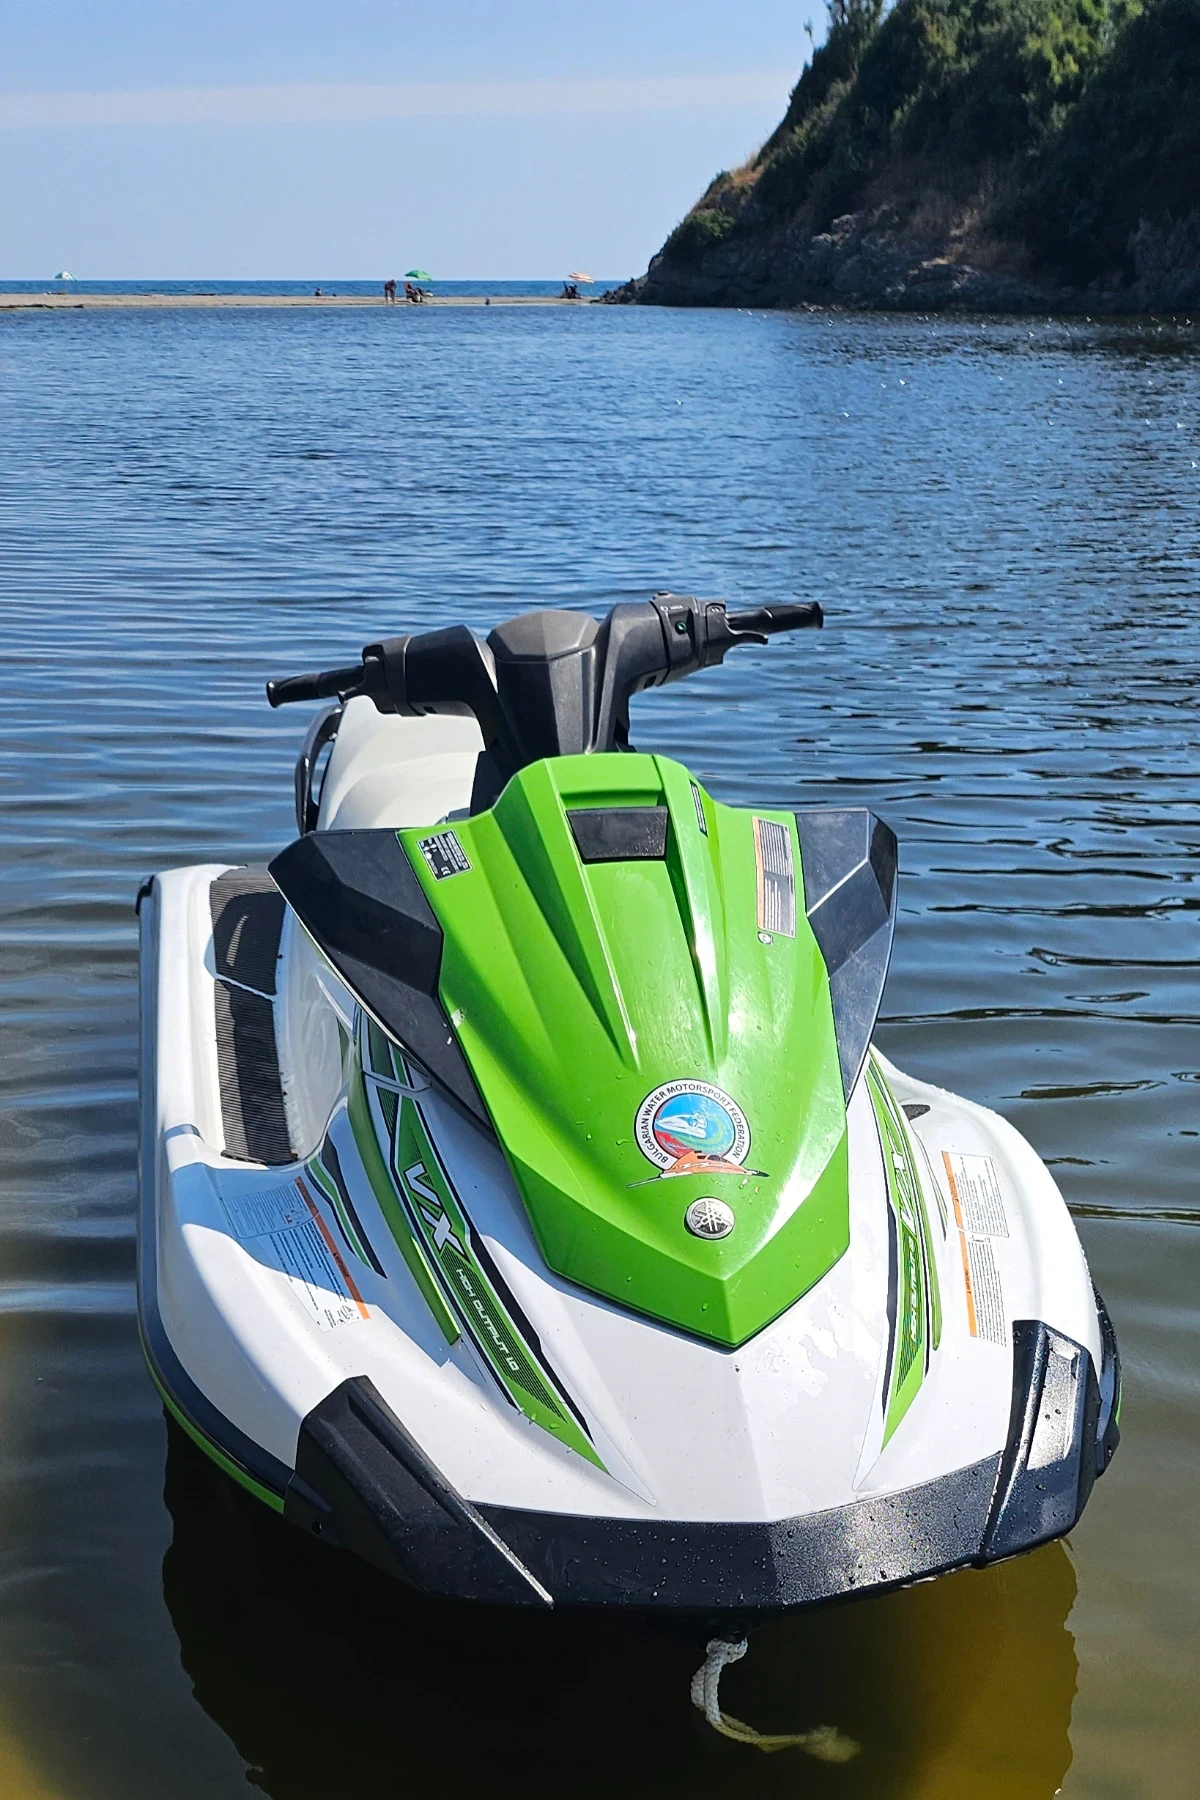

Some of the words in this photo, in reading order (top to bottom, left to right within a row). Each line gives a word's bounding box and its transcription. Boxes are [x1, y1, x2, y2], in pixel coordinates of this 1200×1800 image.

[643, 1091, 667, 1116] WATER
[666, 1083, 732, 1109] MOTORSPORT
[640, 1117, 669, 1164] BULGARIAN
[728, 1107, 745, 1159] FEDERATION
[403, 1160, 472, 1265] VX
[456, 1268, 476, 1297] HIGH
[473, 1299, 510, 1355] OUTPUT
[506, 1356, 520, 1371] 1.0
